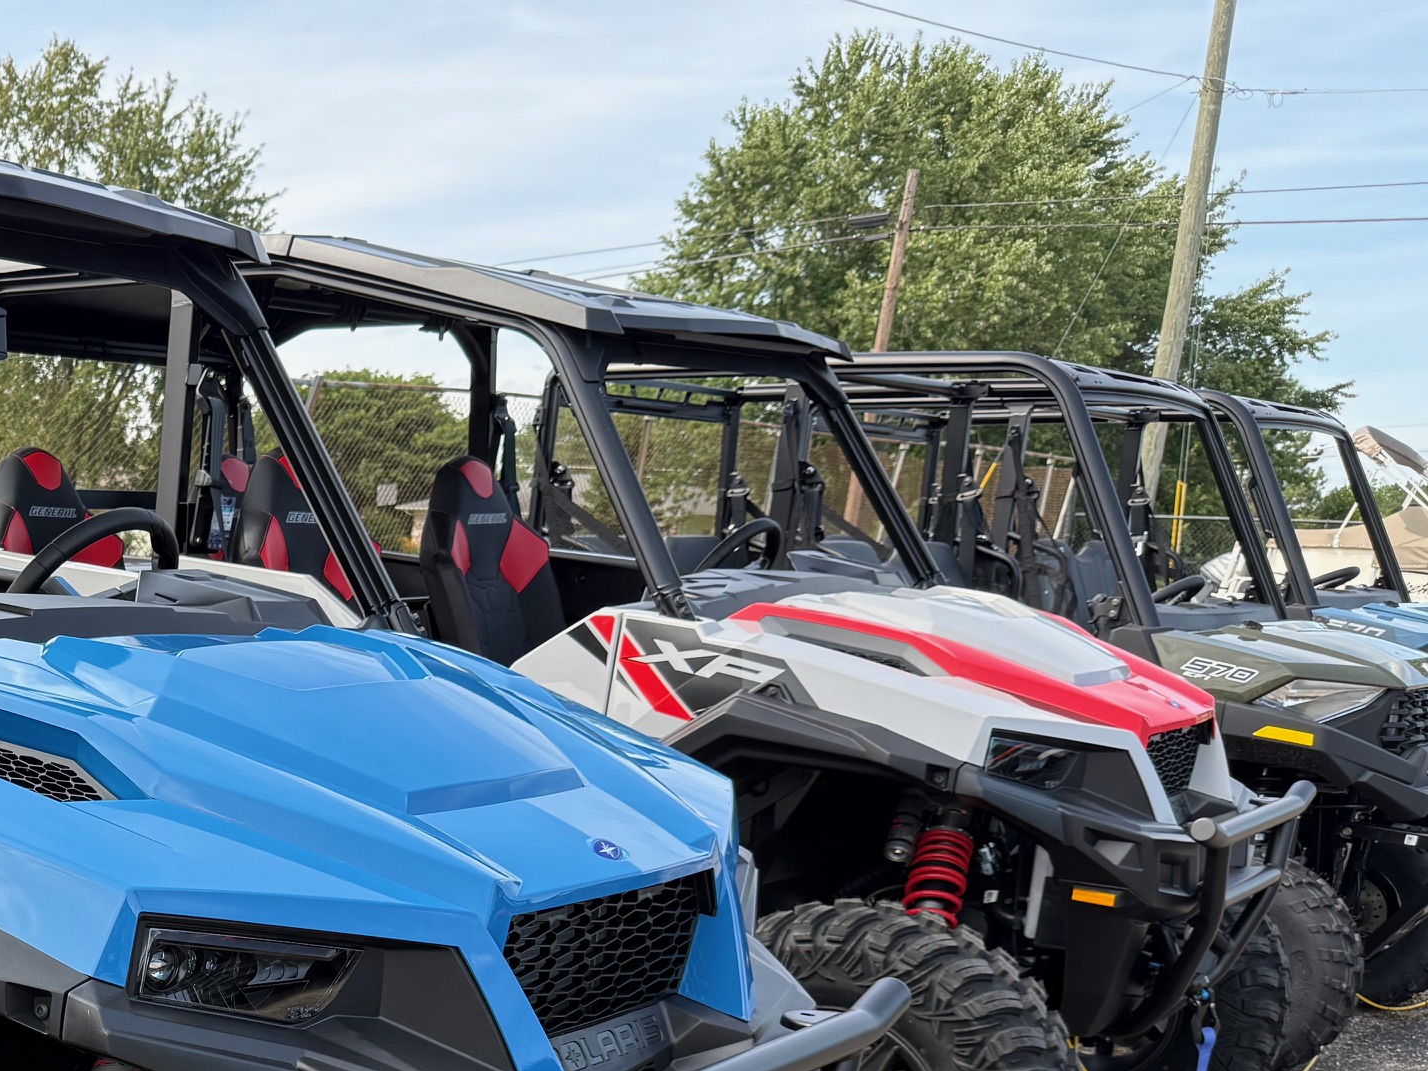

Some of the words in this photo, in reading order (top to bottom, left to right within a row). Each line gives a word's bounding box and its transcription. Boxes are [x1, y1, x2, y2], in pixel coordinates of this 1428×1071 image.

[29, 506, 77, 518] GENERAL
[286, 511, 318, 524] GENE
[627, 638, 786, 683] XP
[1180, 656, 1260, 684] 570
